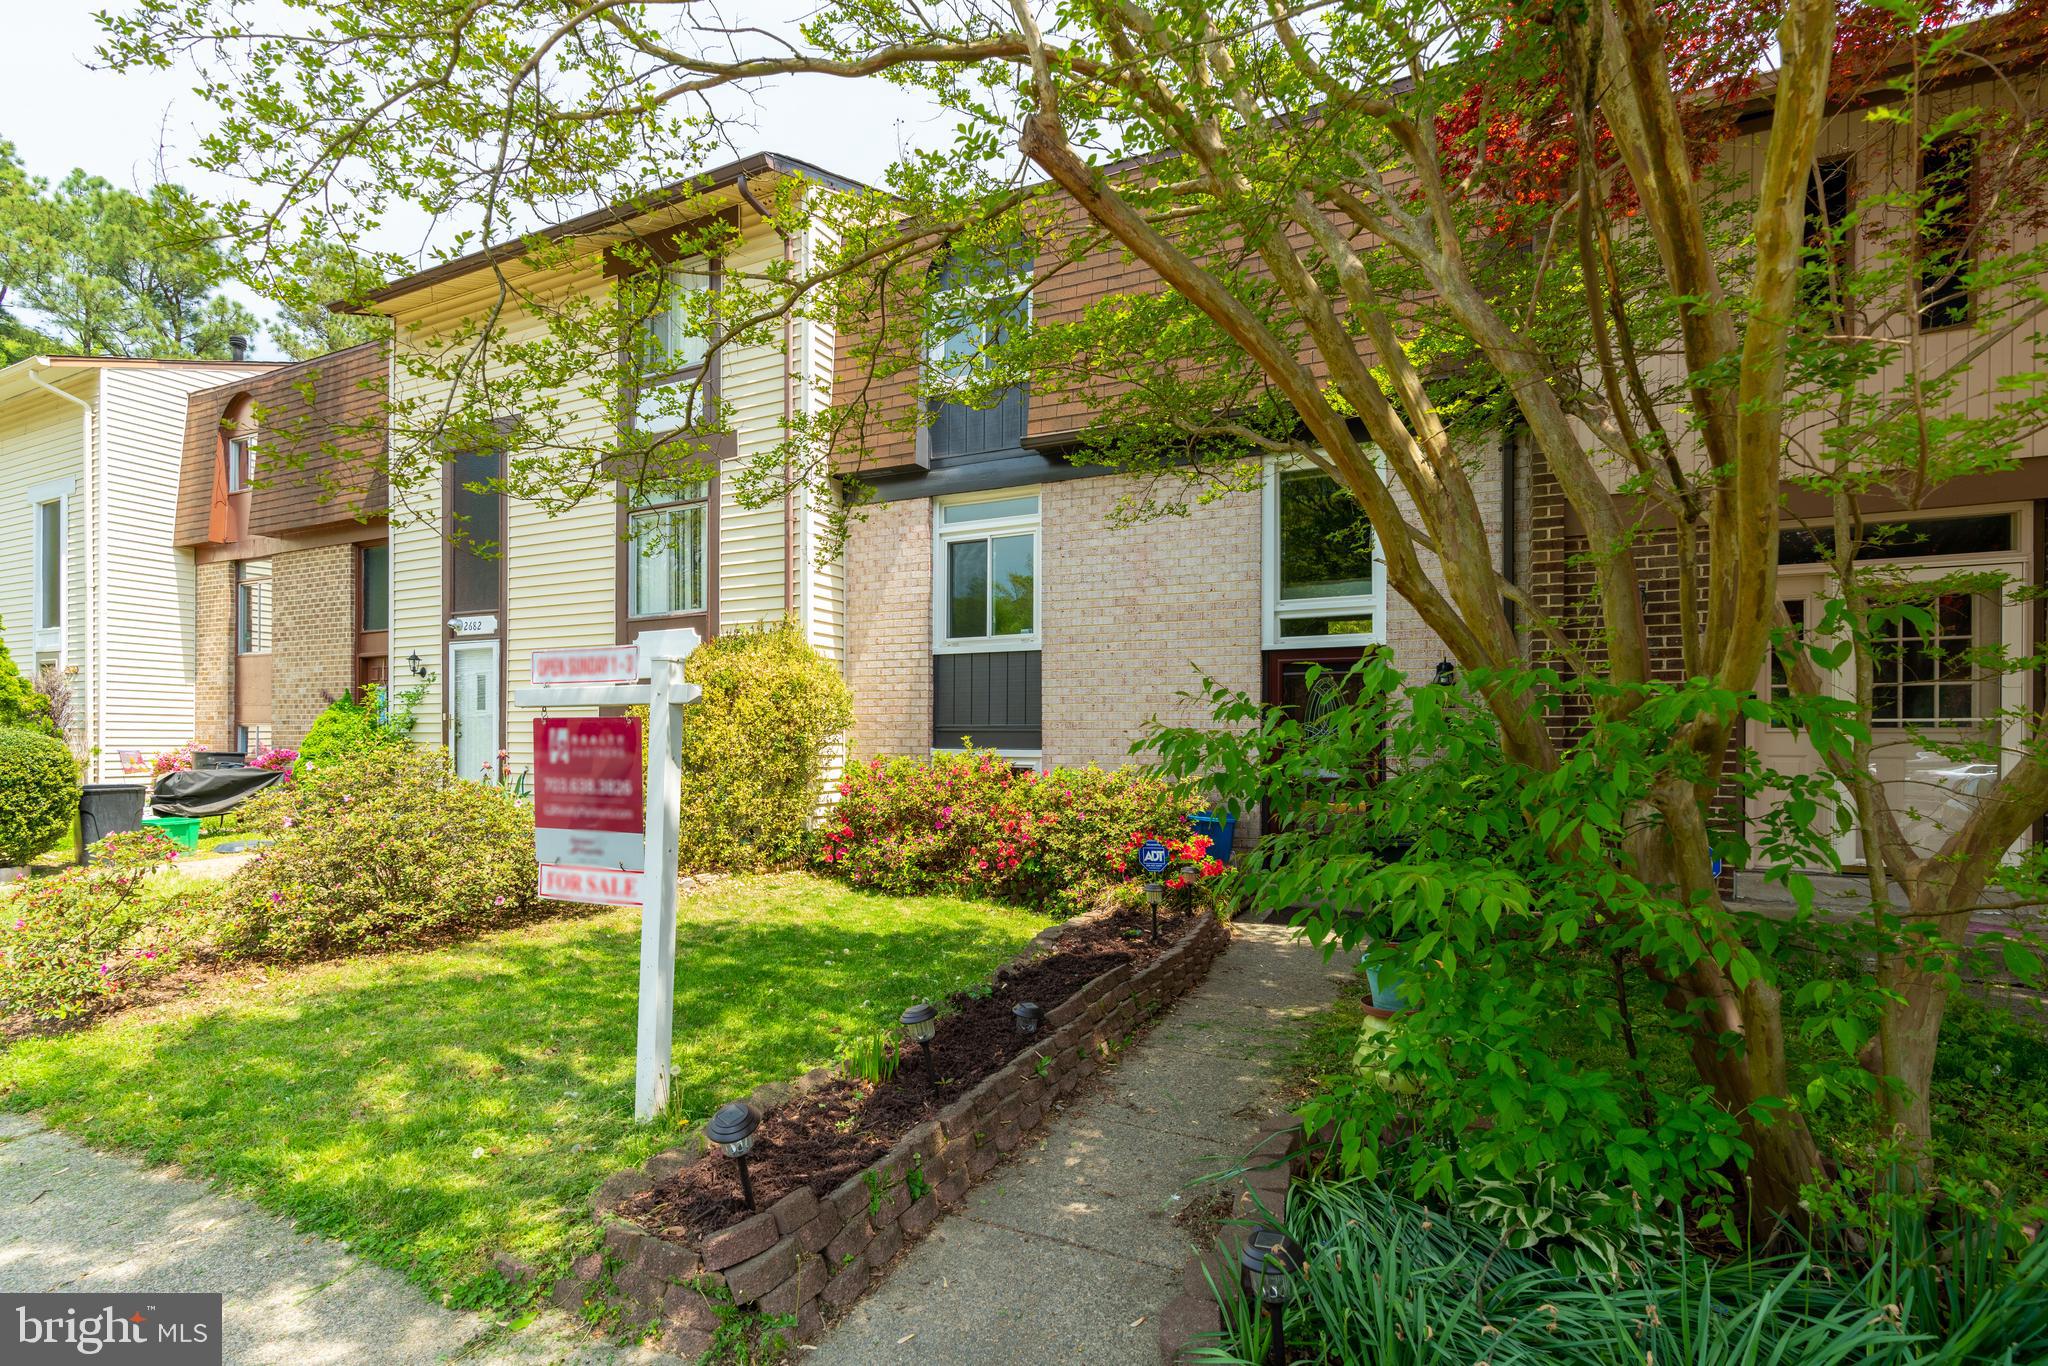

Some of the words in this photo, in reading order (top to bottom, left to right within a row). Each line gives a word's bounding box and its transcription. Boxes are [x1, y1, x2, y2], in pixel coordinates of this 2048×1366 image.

[463, 621, 482, 631] 2682
[1144, 850, 1165, 862] ADT
[546, 871, 582, 893] FOR
[586, 875, 638, 897] SALE
